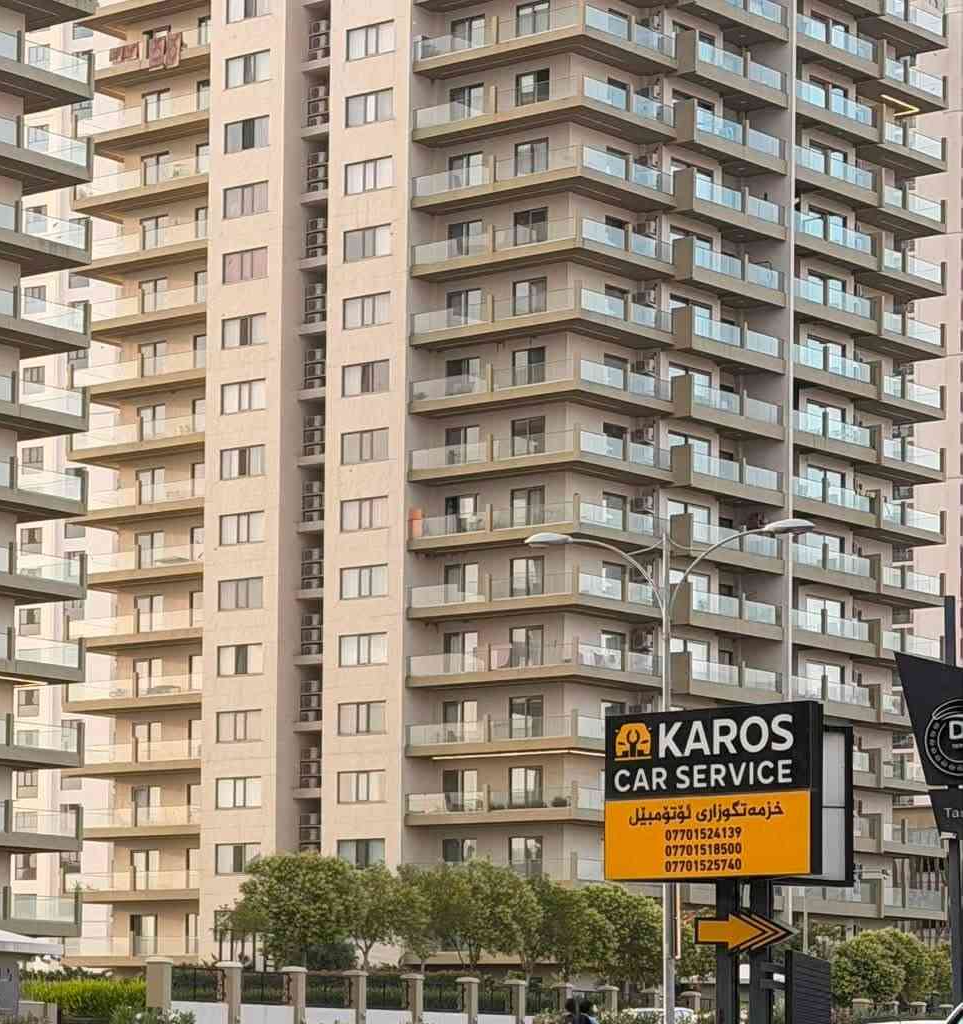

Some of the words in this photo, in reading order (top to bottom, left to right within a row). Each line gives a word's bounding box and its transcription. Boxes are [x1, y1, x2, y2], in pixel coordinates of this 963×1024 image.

[658, 713, 794, 758] KAROS
[614, 767, 668, 792] CAR
[676, 759, 793, 789] SERVICE
[665, 827, 742, 841] 07701524139
[665, 843, 742, 857] 07701518500
[665, 859, 742, 873] 07701525740
